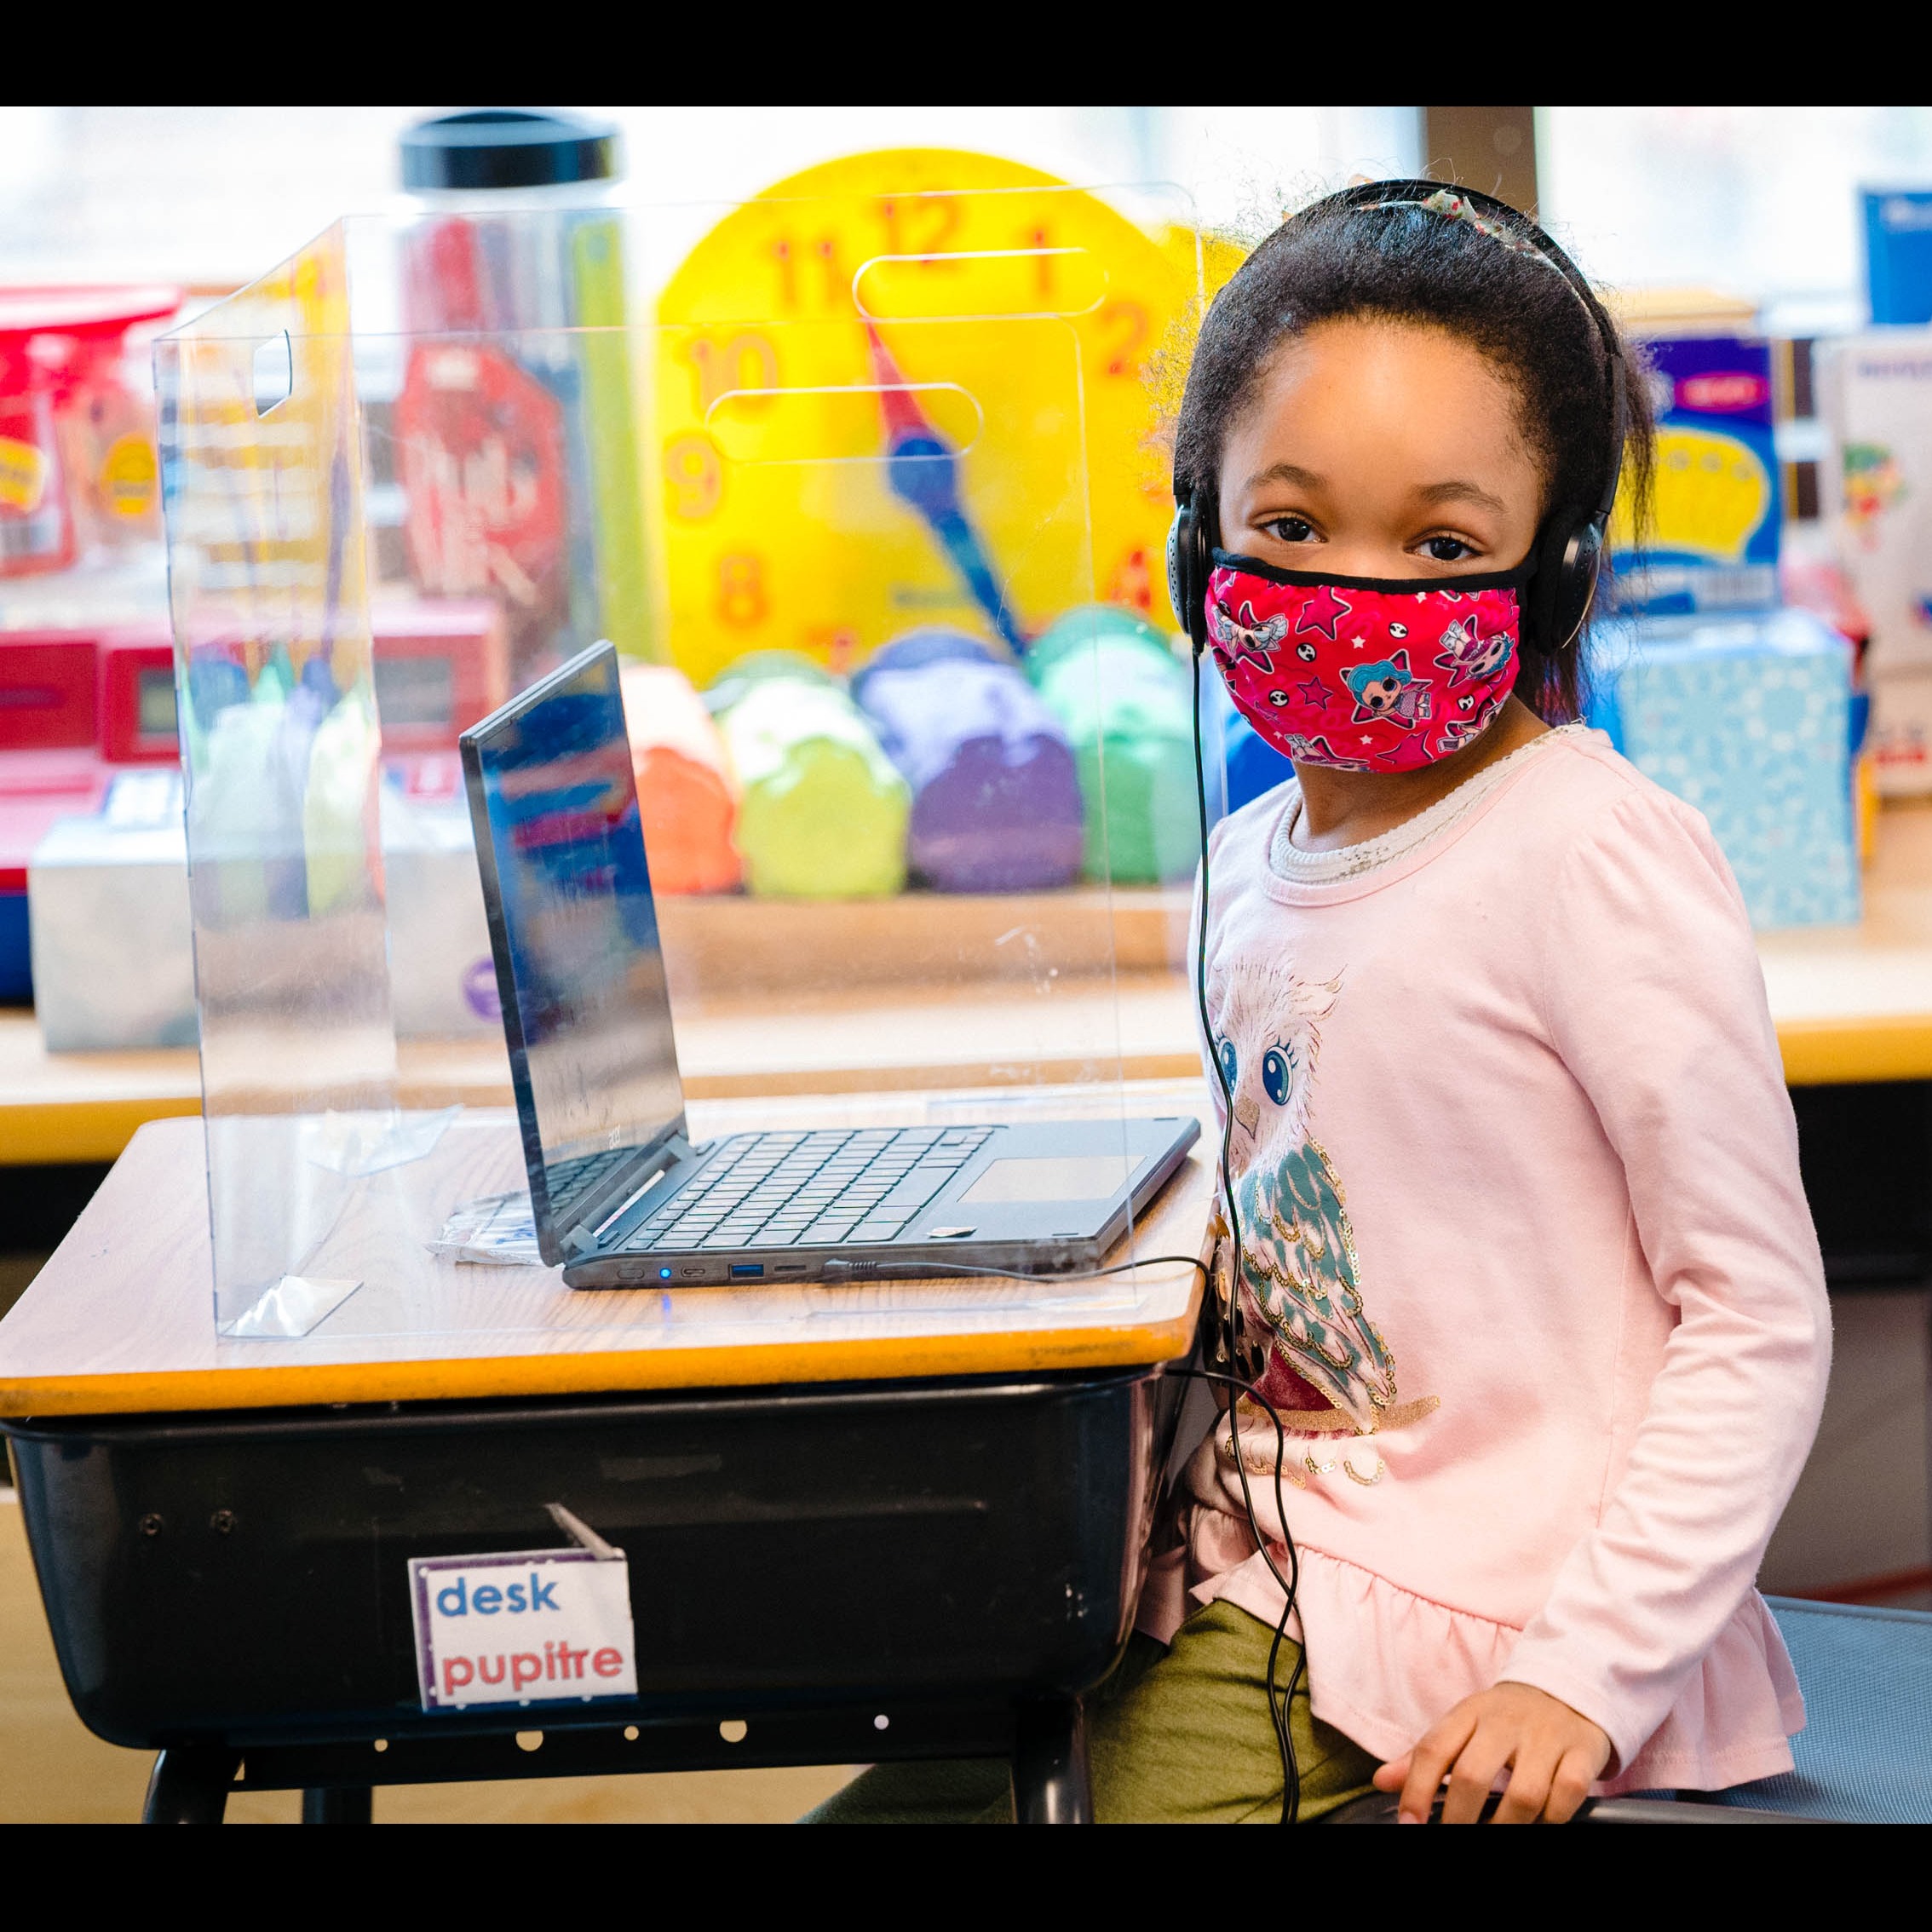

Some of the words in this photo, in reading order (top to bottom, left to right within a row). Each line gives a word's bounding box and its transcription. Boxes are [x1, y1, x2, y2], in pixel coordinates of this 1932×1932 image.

[1027, 225, 1056, 298] 1
[691, 334, 779, 414] 10
[1102, 301, 1150, 377] 2
[664, 434, 722, 519] 9
[716, 552, 770, 632] 8
[437, 1573, 561, 1617] desk
[442, 1641, 624, 1696] pupitre
